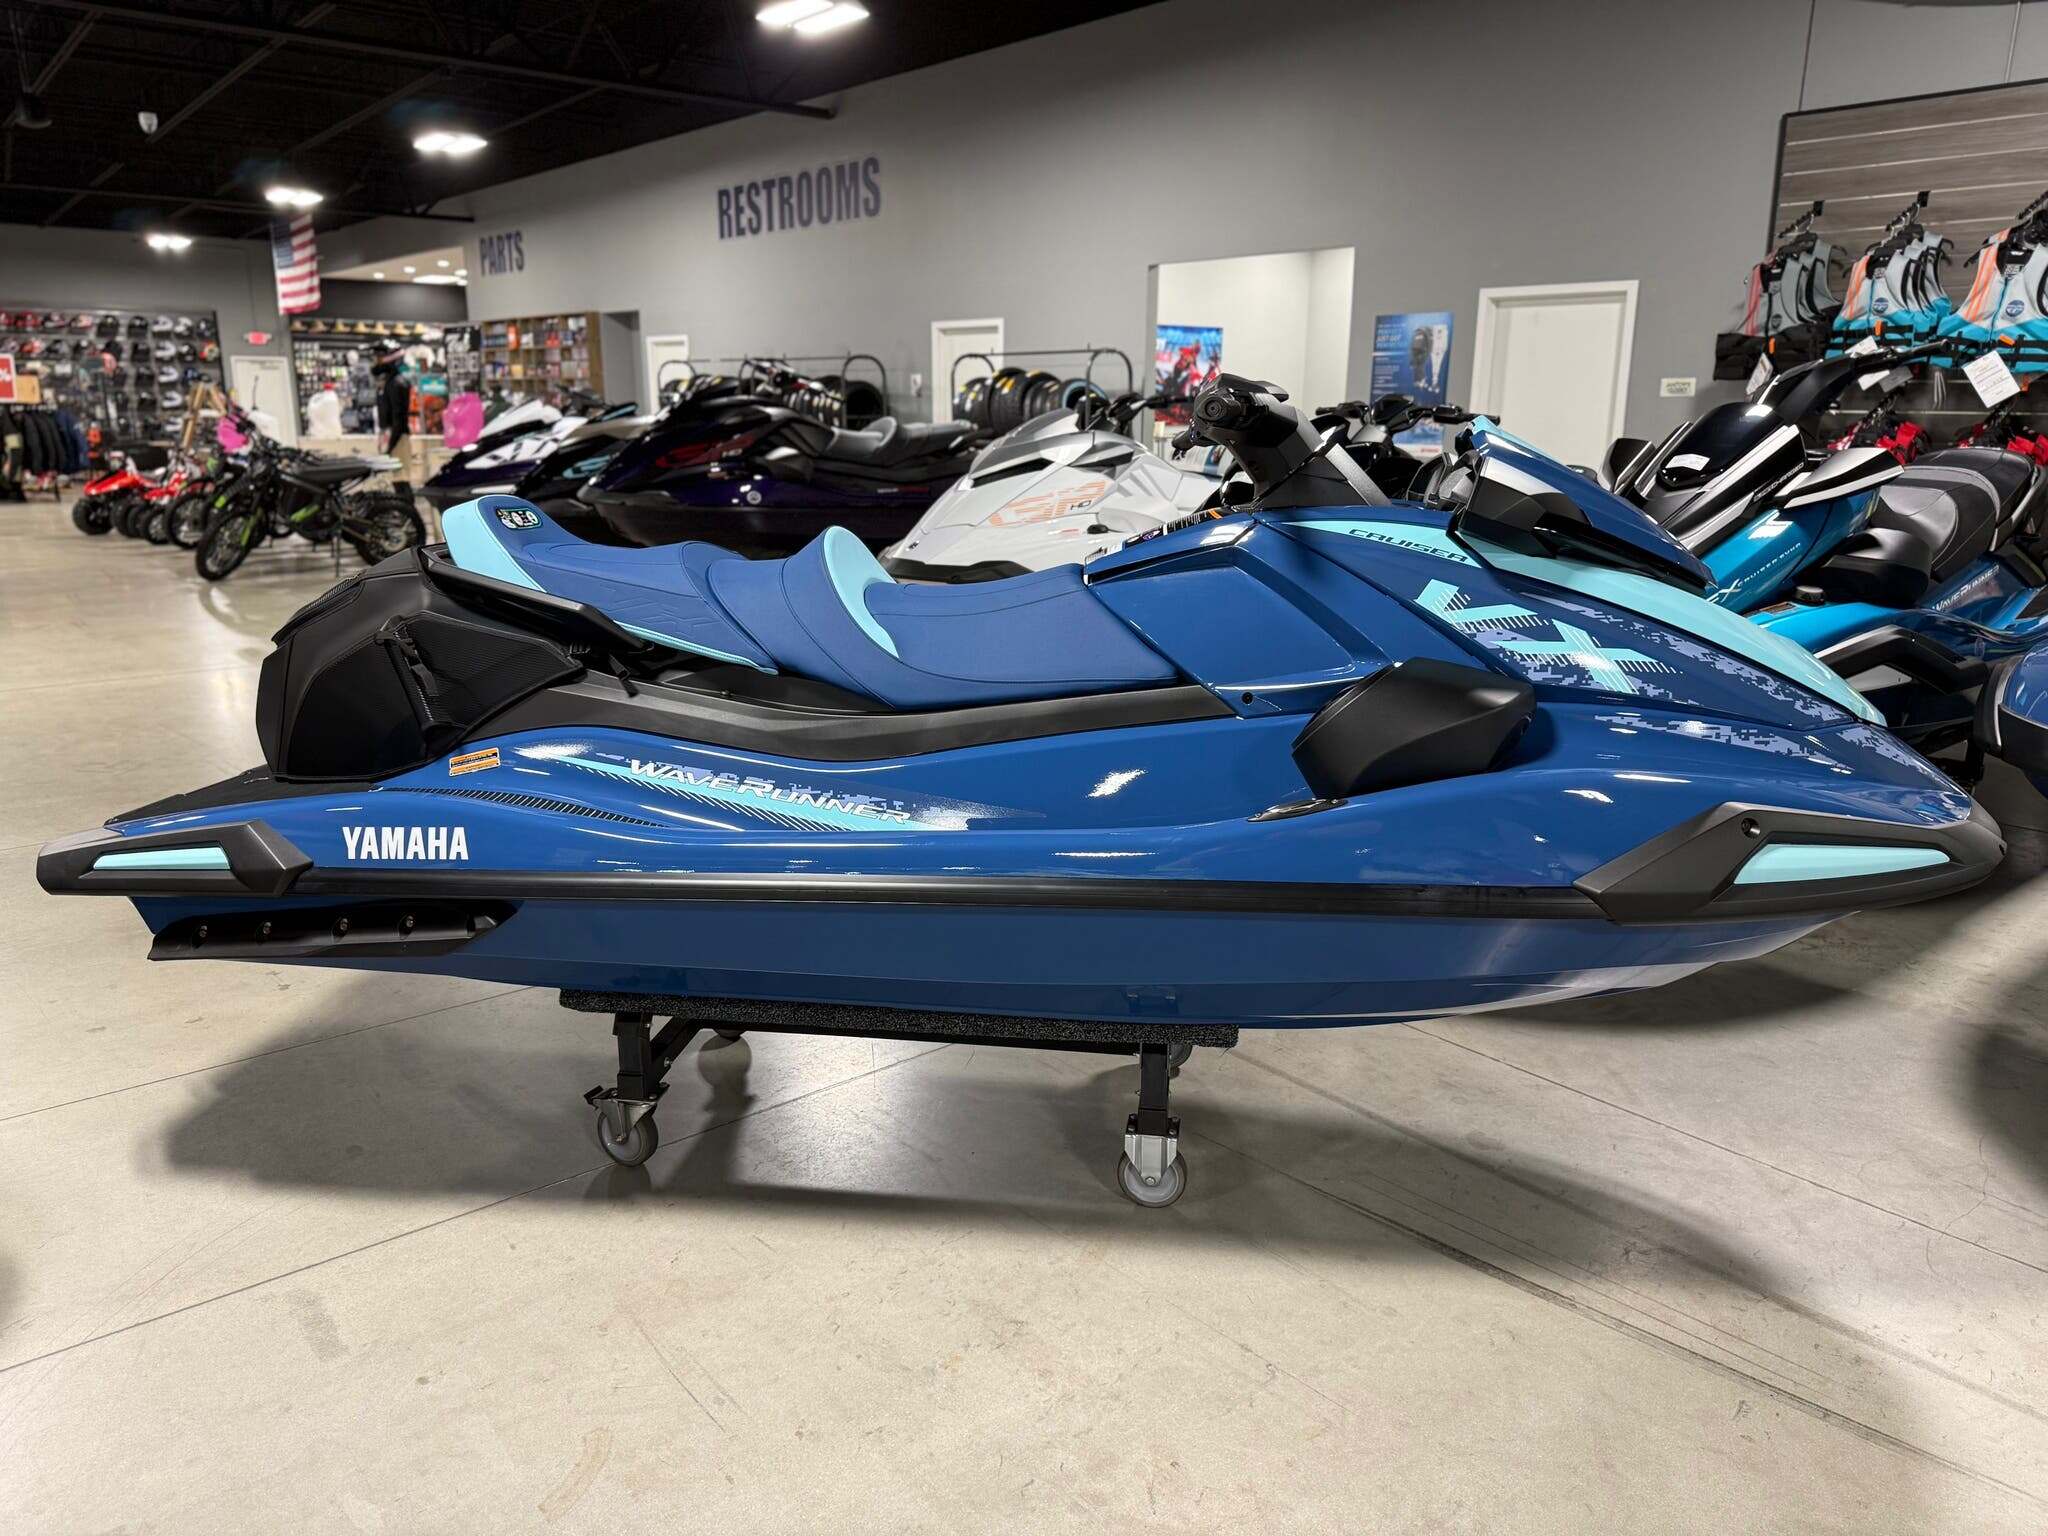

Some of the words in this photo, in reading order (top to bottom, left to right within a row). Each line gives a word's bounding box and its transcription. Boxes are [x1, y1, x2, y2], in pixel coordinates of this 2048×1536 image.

[717, 156, 882, 239] RESTROOMS
[480, 230, 525, 277] PARTS
[1348, 528, 1469, 563] CRUISER
[1412, 577, 1670, 695] VX
[342, 826, 469, 860] YAMAHA
